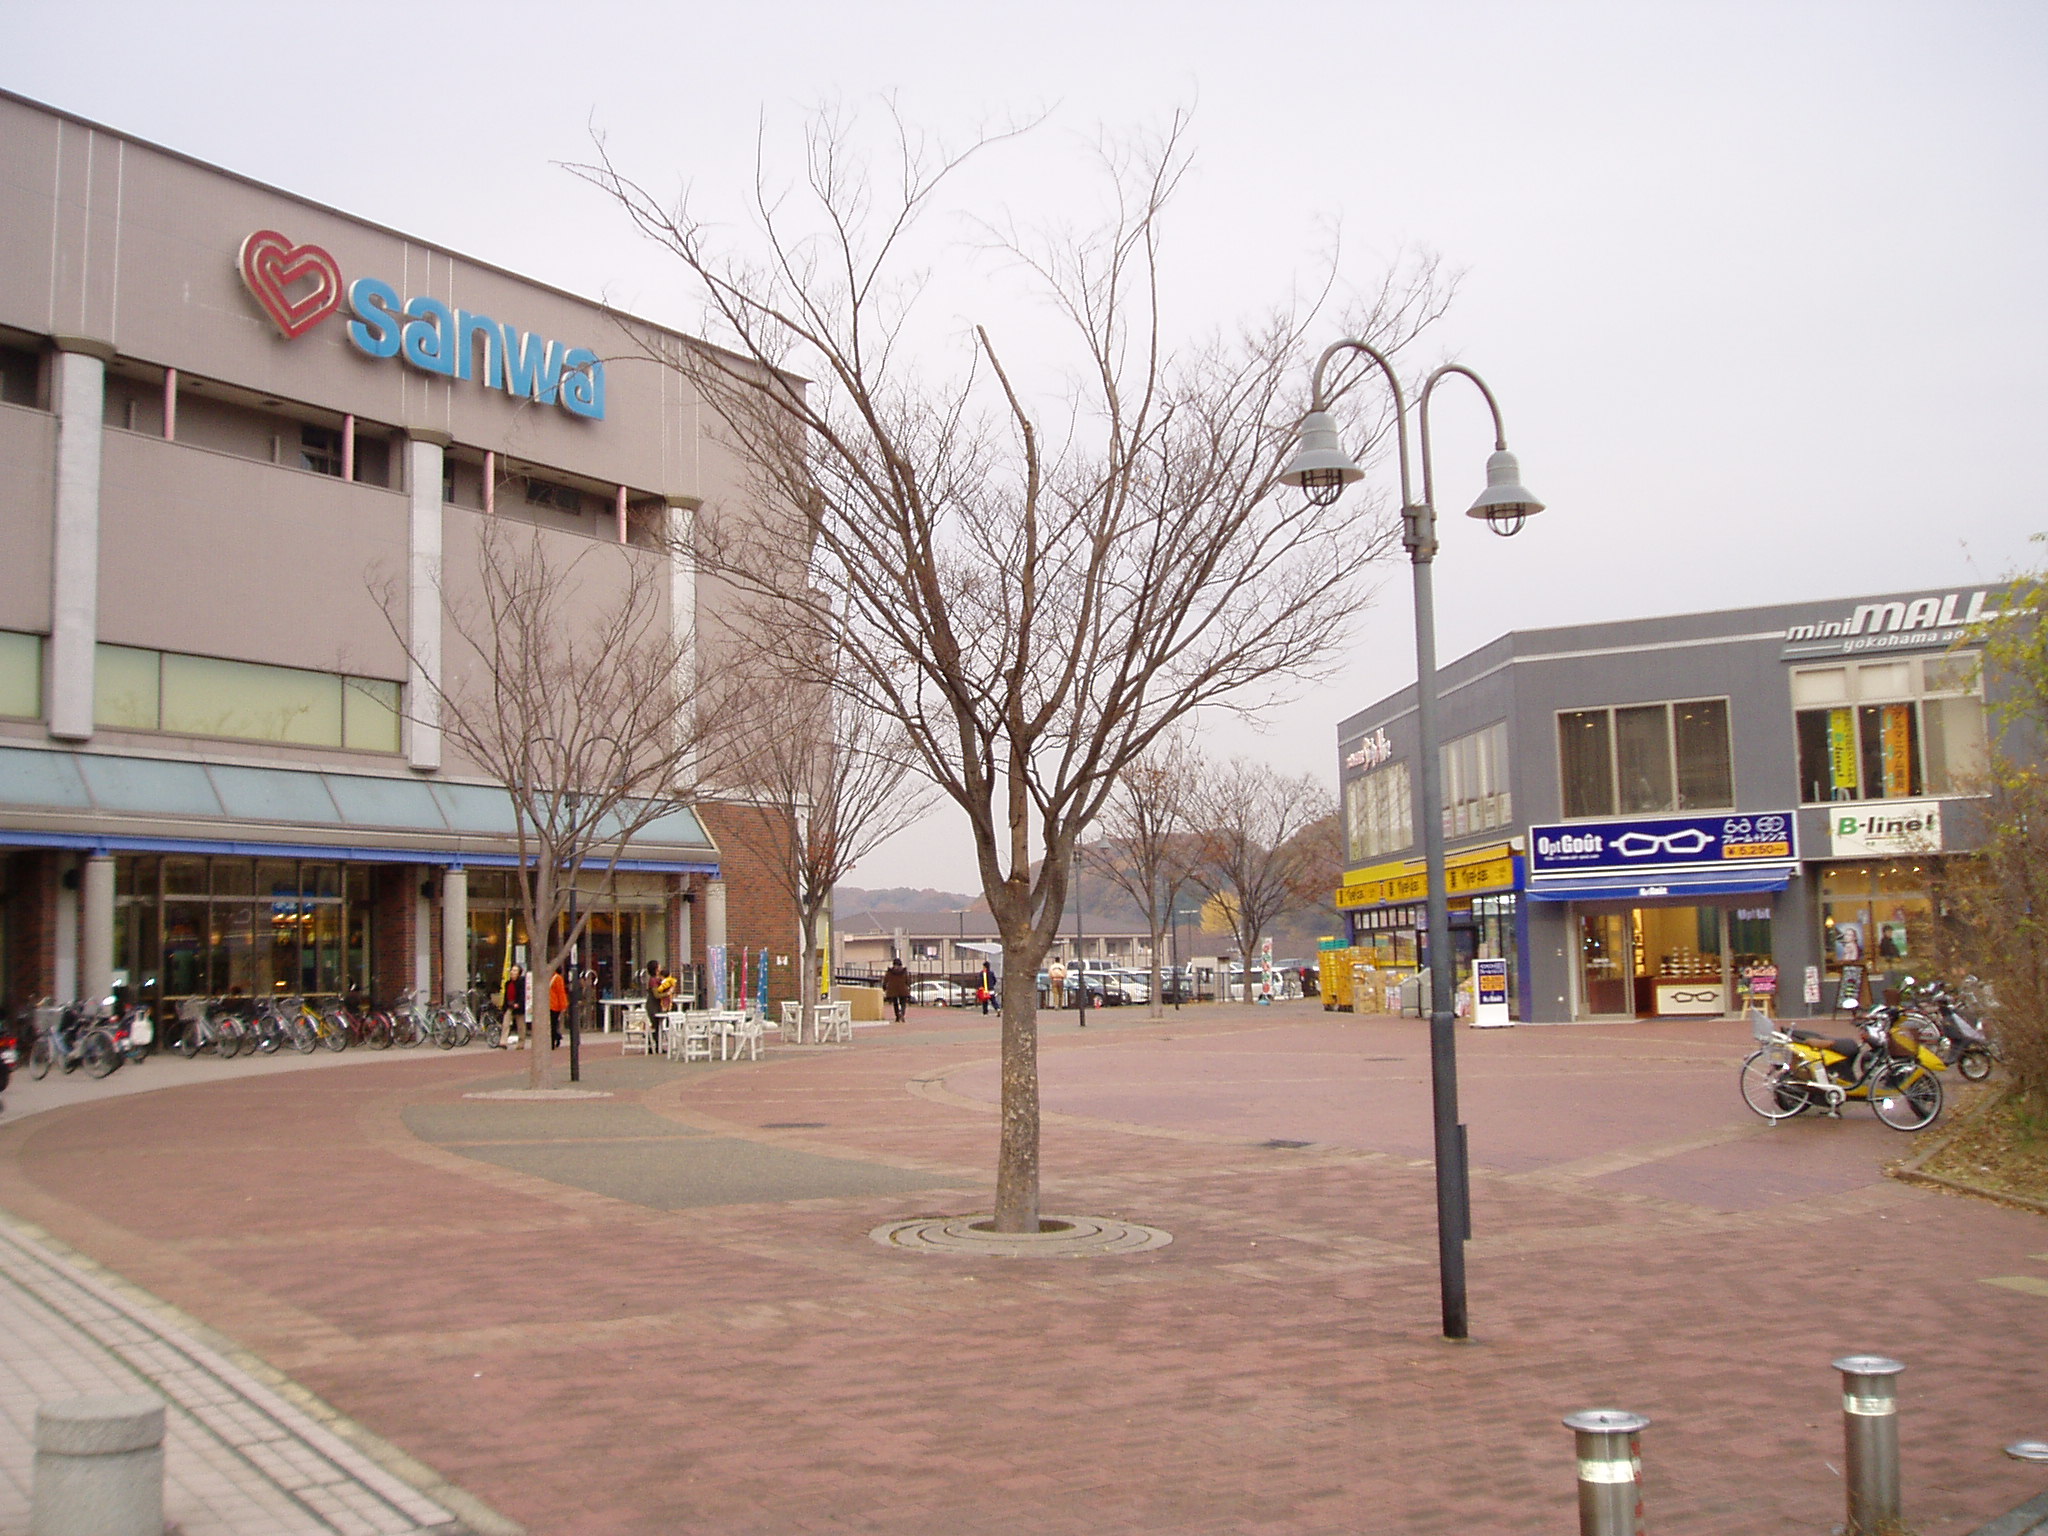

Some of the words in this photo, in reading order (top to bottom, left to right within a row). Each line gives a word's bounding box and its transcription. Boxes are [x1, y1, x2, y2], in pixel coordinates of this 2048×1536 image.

[346, 277, 605, 420] sanwa
[1843, 631, 1936, 654] yokohama
[1838, 814, 1934, 835] B-line!
